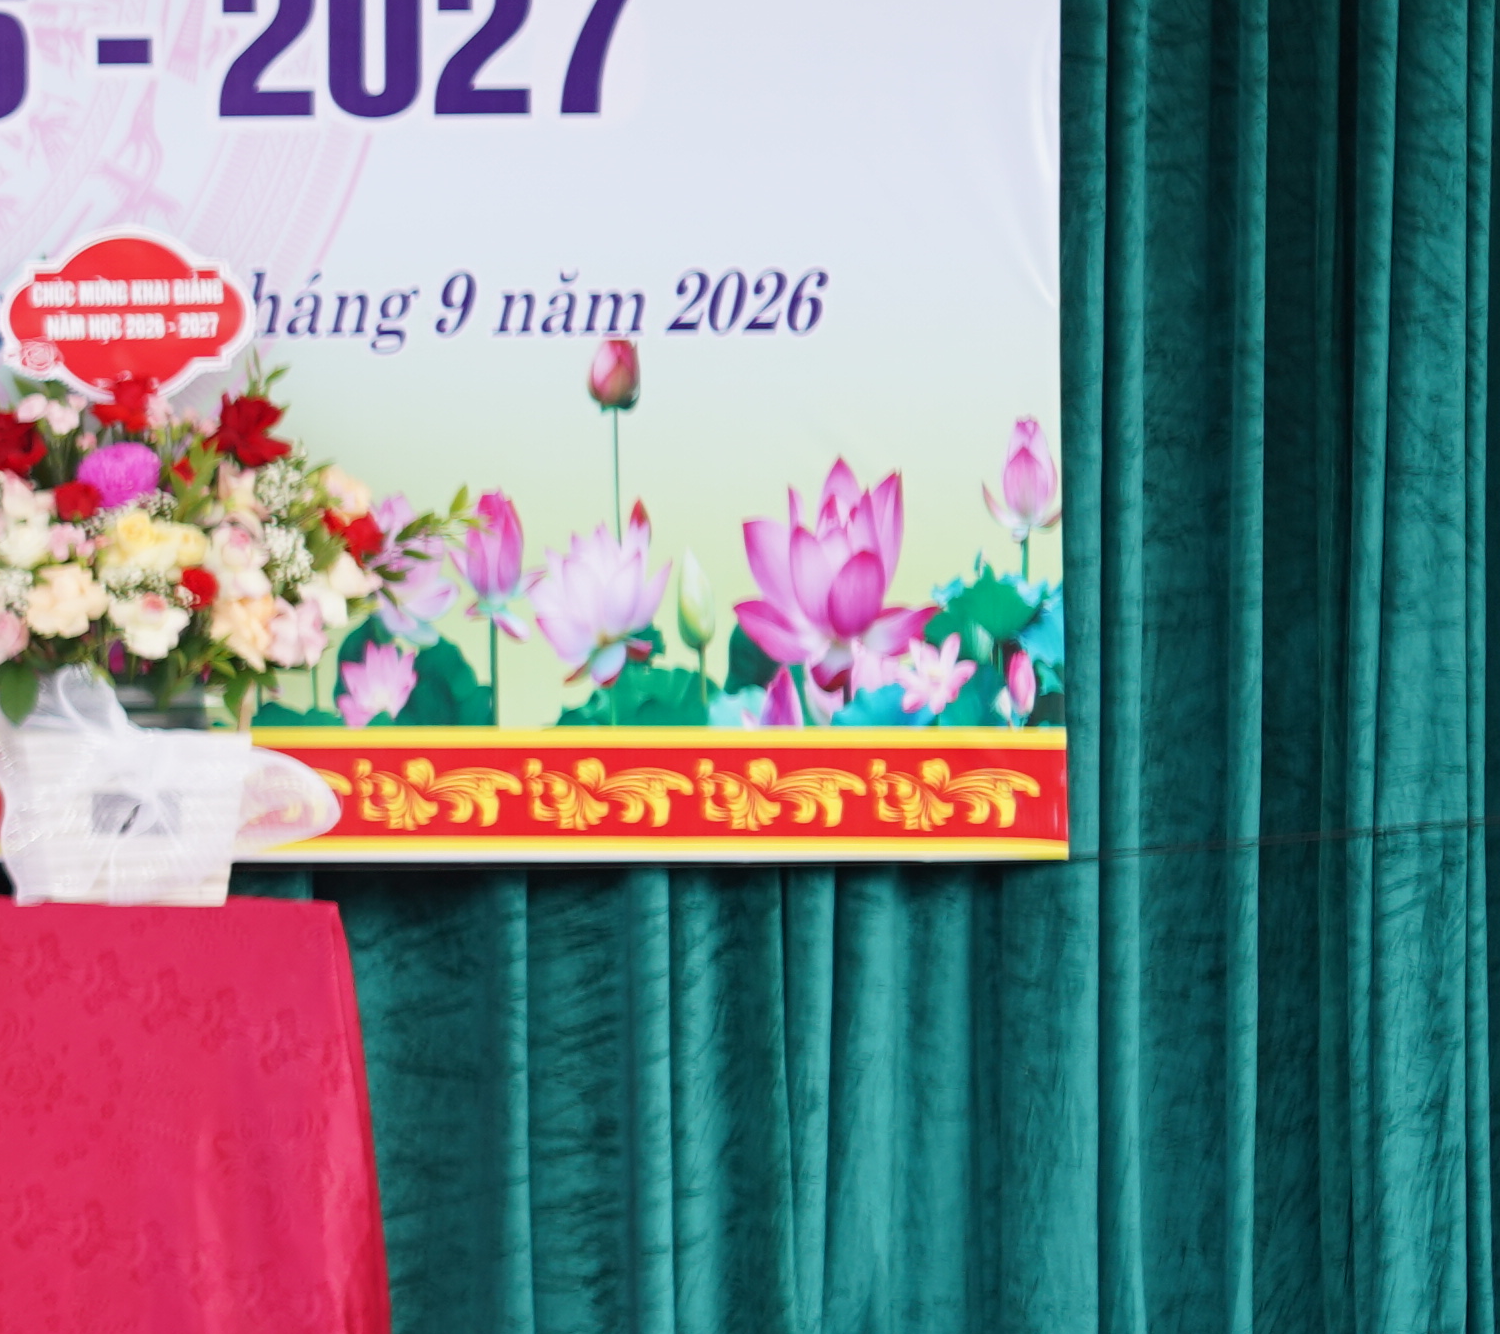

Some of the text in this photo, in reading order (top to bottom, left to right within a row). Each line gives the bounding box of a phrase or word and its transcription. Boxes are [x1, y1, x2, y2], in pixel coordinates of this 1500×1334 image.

[97, 38, 150, 65] -
[30, 269, 224, 309] CHÚC MỪNG KHAI GIẢNG
[87, 312, 122, 345] HỌC
[177, 311, 220, 339] 2027
[251, 271, 420, 355] háng
[434, 269, 478, 335] 9
[493, 267, 646, 338] năm
[664, 269, 830, 335] 2026
